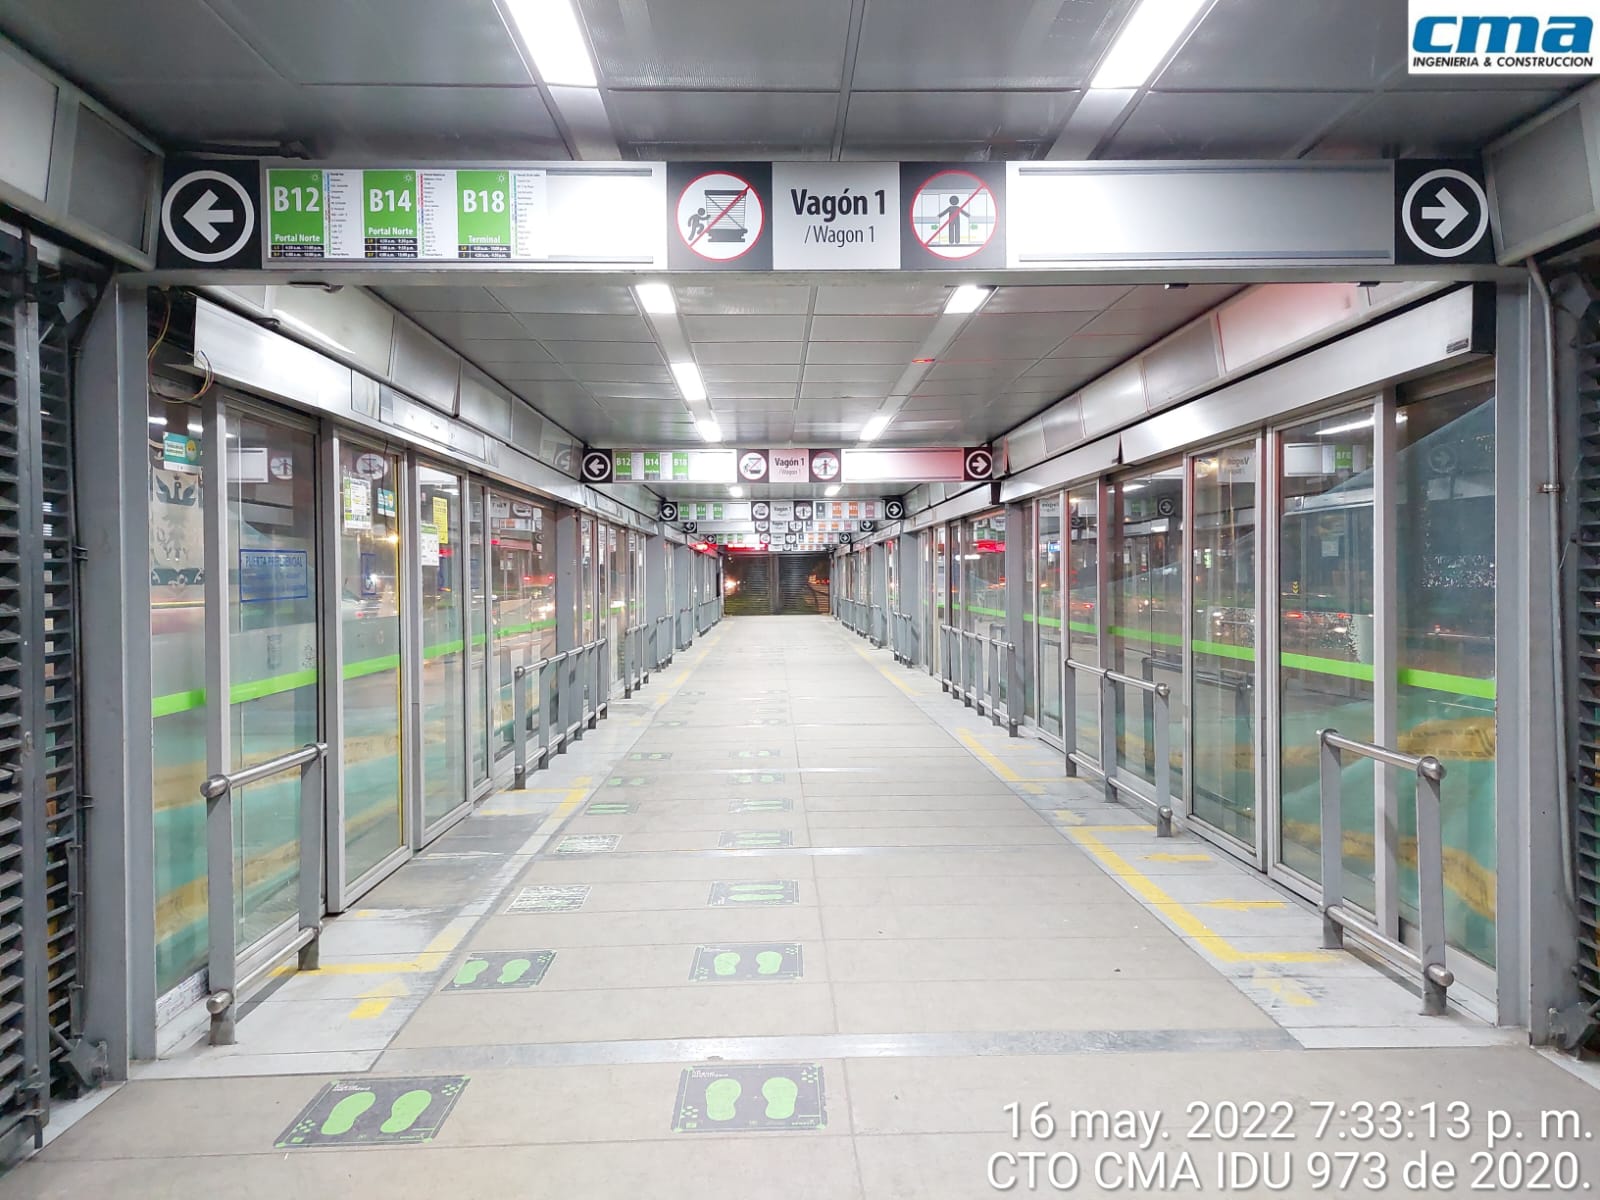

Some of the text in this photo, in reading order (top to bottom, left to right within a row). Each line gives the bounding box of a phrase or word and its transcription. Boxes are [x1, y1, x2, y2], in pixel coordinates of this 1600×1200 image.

[273, 186, 320, 212] B12
[369, 188, 412, 213] B14
[463, 189, 505, 213] B18
[790, 187, 885, 223] Vagón 1
[274, 233, 321, 242] Portal Norte
[368, 227, 414, 236] Portal Norte
[468, 234, 501, 244] Terminal
[868, 225, 875, 243] 1
[616, 457, 631, 466] B12
[645, 458, 659, 466] B14
[774, 456, 805, 469] Vagón 1
